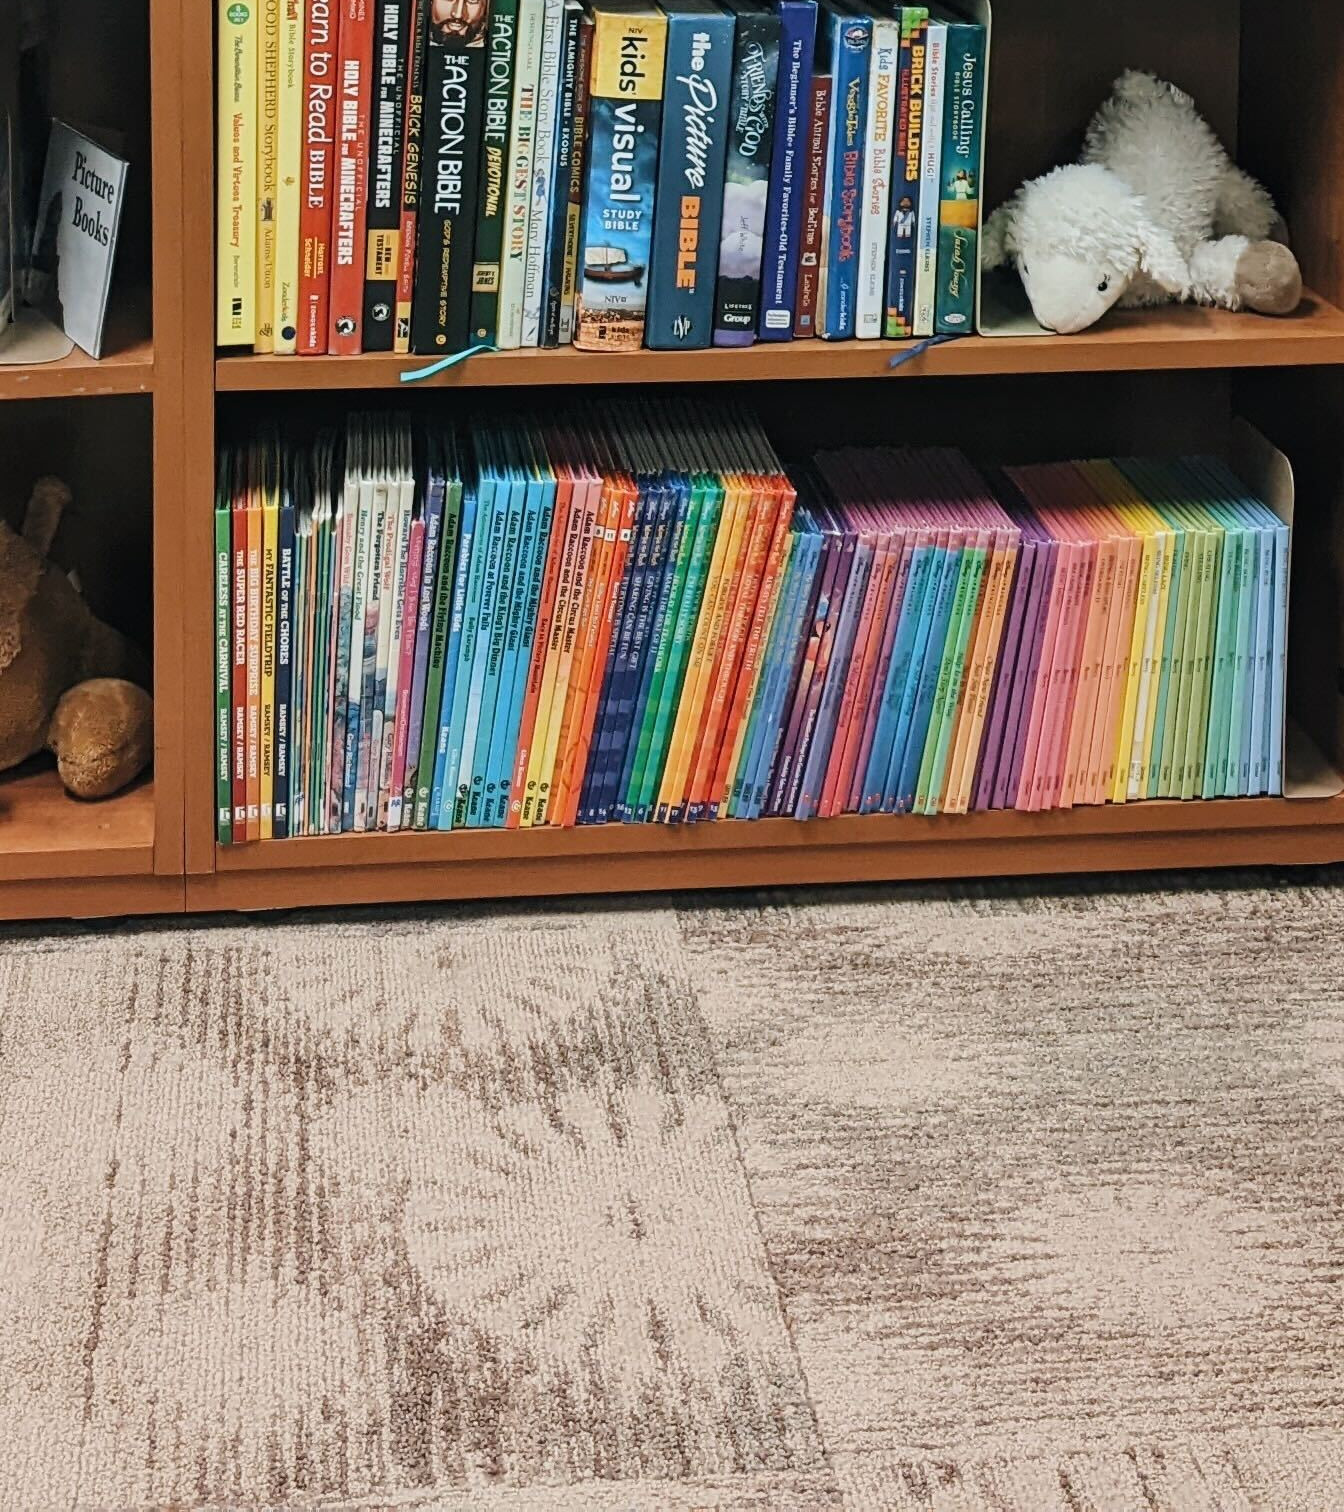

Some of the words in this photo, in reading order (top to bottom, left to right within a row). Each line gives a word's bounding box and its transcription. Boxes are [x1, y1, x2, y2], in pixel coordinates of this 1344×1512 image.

[383, 4, 399, 41] HOLY
[309, 52, 332, 76] to
[343, 60, 360, 96] HOLY
[381, 44, 398, 85] BIBLE
[443, 55, 470, 65] THE
[488, 22, 512, 94] ACTION
[690, 32, 711, 70] the
[910, 45, 925, 100] BRICK
[962, 53, 977, 96] Jesus
[307, 83, 333, 144] Read
[341, 100, 358, 142] BIBLE
[408, 95, 422, 136] BRICK
[438, 66, 468, 155] ACTION
[484, 98, 506, 142] BIBLE
[519, 84, 534, 121] THE
[677, 71, 718, 189] Picture
[957, 99, 977, 159] Calling
[375, 100, 395, 208] MINECRAFTERS
[513, 126, 532, 202] BIGGEST
[610, 103, 643, 202] visual
[905, 100, 923, 182] BUILDERS
[71, 150, 115, 205] Picture
[309, 149, 325, 209] BIBLE
[405, 142, 419, 205] GENESIS
[434, 159, 463, 216] BIBLE
[71, 196, 110, 247] Books
[337, 157, 356, 265] MINECRAFTERS
[510, 204, 525, 263] STORY
[602, 208, 643, 221] STUDY
[605, 220, 640, 232] BIBLE
[675, 195, 701, 289] BIBLE
[265, 563, 274, 621] FANTASTIC
[264, 624, 274, 677] FIELDTRIP
